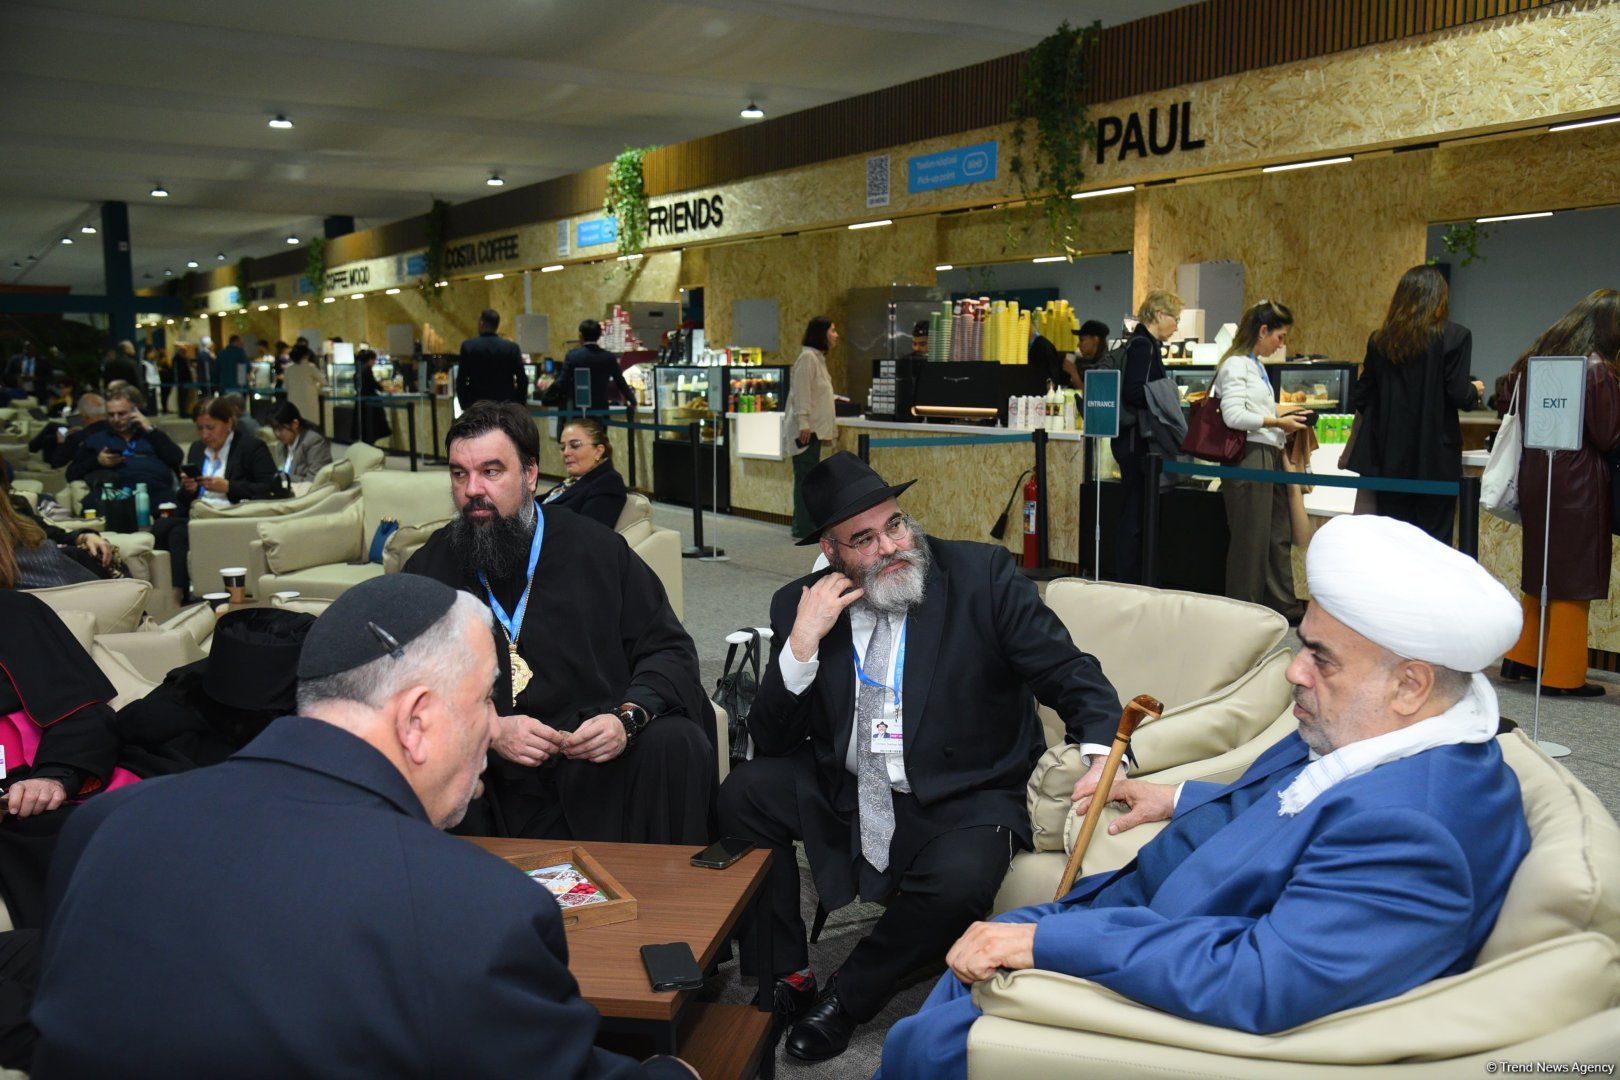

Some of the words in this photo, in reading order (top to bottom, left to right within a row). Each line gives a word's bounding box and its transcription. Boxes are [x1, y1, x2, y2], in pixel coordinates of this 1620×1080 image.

[1097, 101, 1205, 164] PAUL
[647, 194, 723, 237] FRIENDS
[445, 243, 477, 269] COSTA
[478, 234, 519, 263] COFFEE
[1087, 400, 1116, 408] ENTRANCE
[1542, 398, 1567, 409] EXIT
